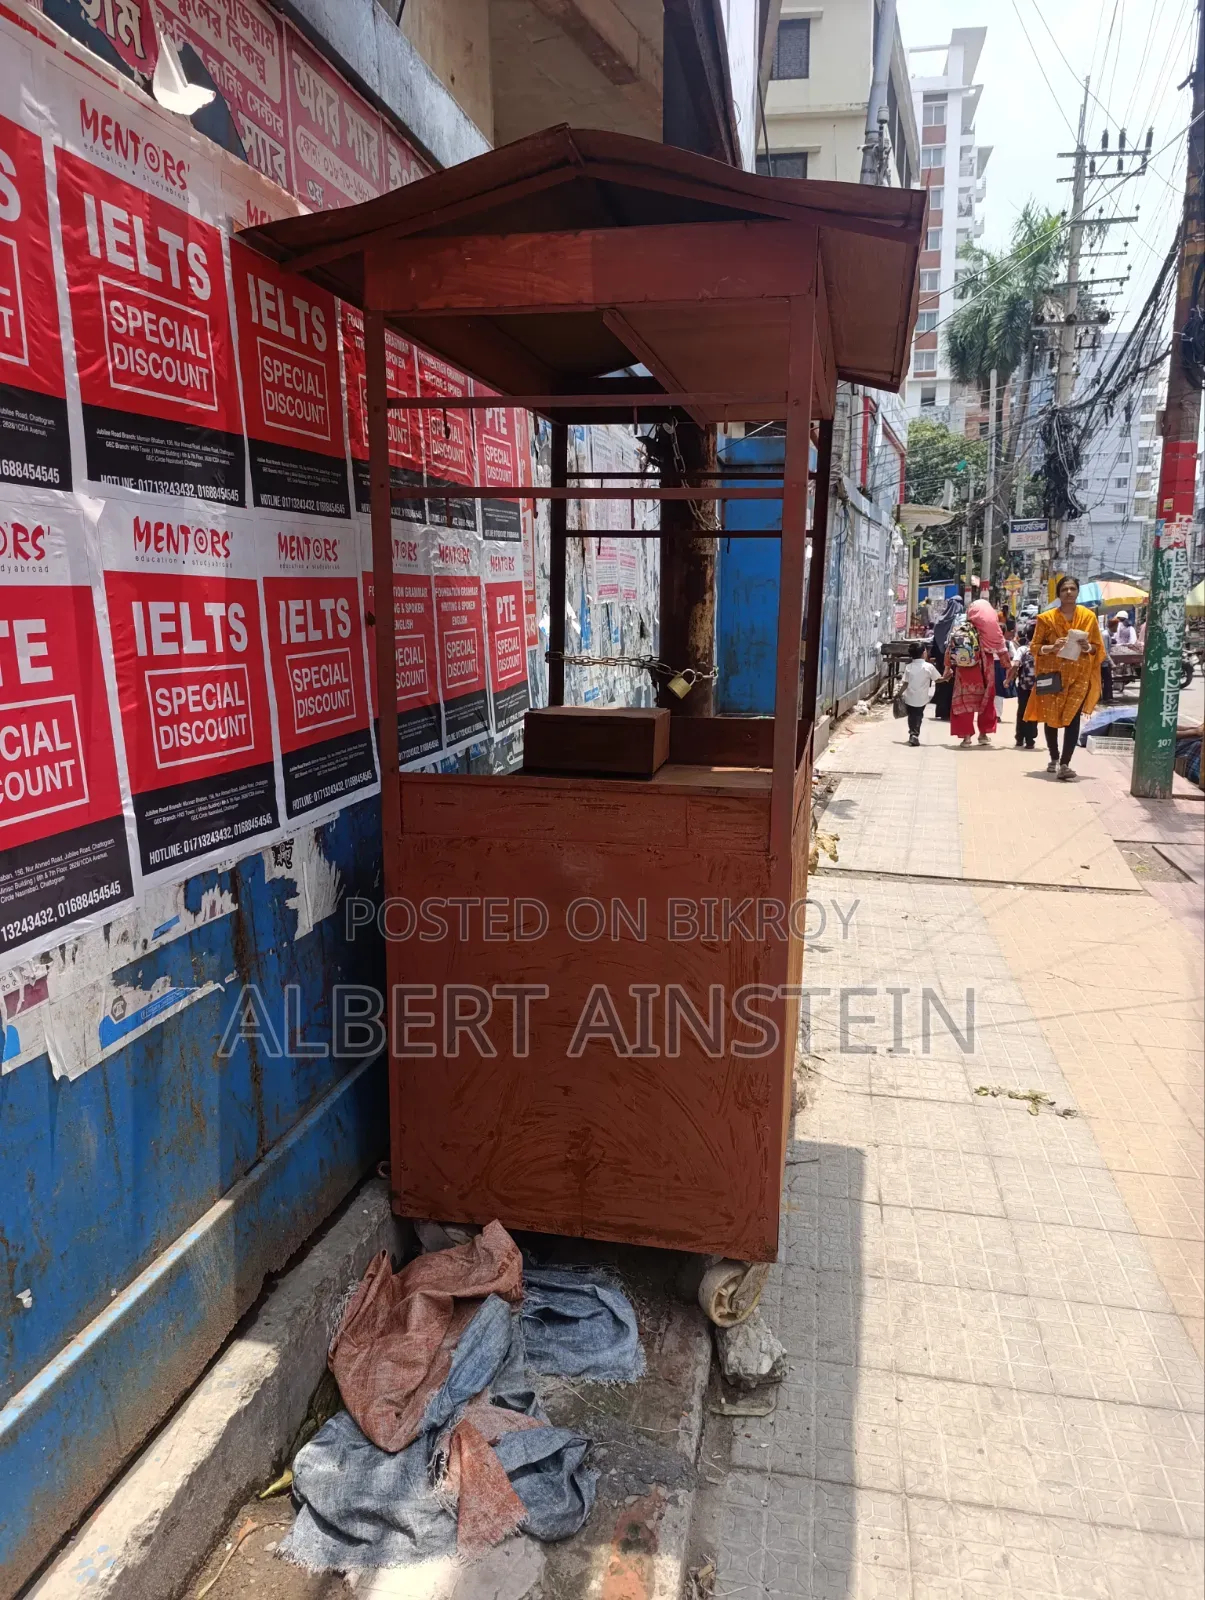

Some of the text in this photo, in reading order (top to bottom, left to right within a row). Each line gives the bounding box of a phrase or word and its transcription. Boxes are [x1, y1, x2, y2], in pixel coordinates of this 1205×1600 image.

[84, 143, 127, 169] education
[84, 193, 211, 300] IELTS
[247, 272, 328, 352] IELTS
[109, 299, 207, 360] SPECIAL
[114, 342, 210, 393] DISCOUNT
[263, 355, 324, 399] SPECIAL
[265, 389, 326, 426] DISCOUNT
[110, 430, 121, 438] Road
[431, 439, 464, 463] DISCOUNT
[485, 444, 511, 467] SPECIAL
[0, 459, 60, 484] 688454545
[0, 564, 49, 573] dyabroad
[278, 597, 351, 645] IELTS
[496, 595, 516, 625] PTE
[132, 601, 248, 657] IELTS
[396, 646, 424, 667] ECIAL
[446, 639, 475, 659] SPECIAL
[497, 636, 519, 656] SPECIAL
[292, 662, 349, 693] SPECIAL
[447, 659, 476, 678] DISCOUNT
[497, 654, 520, 672] DISCOUNT
[396, 669, 425, 691] SCOUNT
[155, 681, 246, 717] SPECIAL
[296, 689, 351, 719] DISCOUNT
[0, 718, 72, 762] CIAL
[159, 713, 247, 750] DISCOUNT
[1157, 738, 1172, 748] 107
[149, 842, 183, 865] HOTLINE:
[0, 880, 121, 942] 13243432, 01688454545
